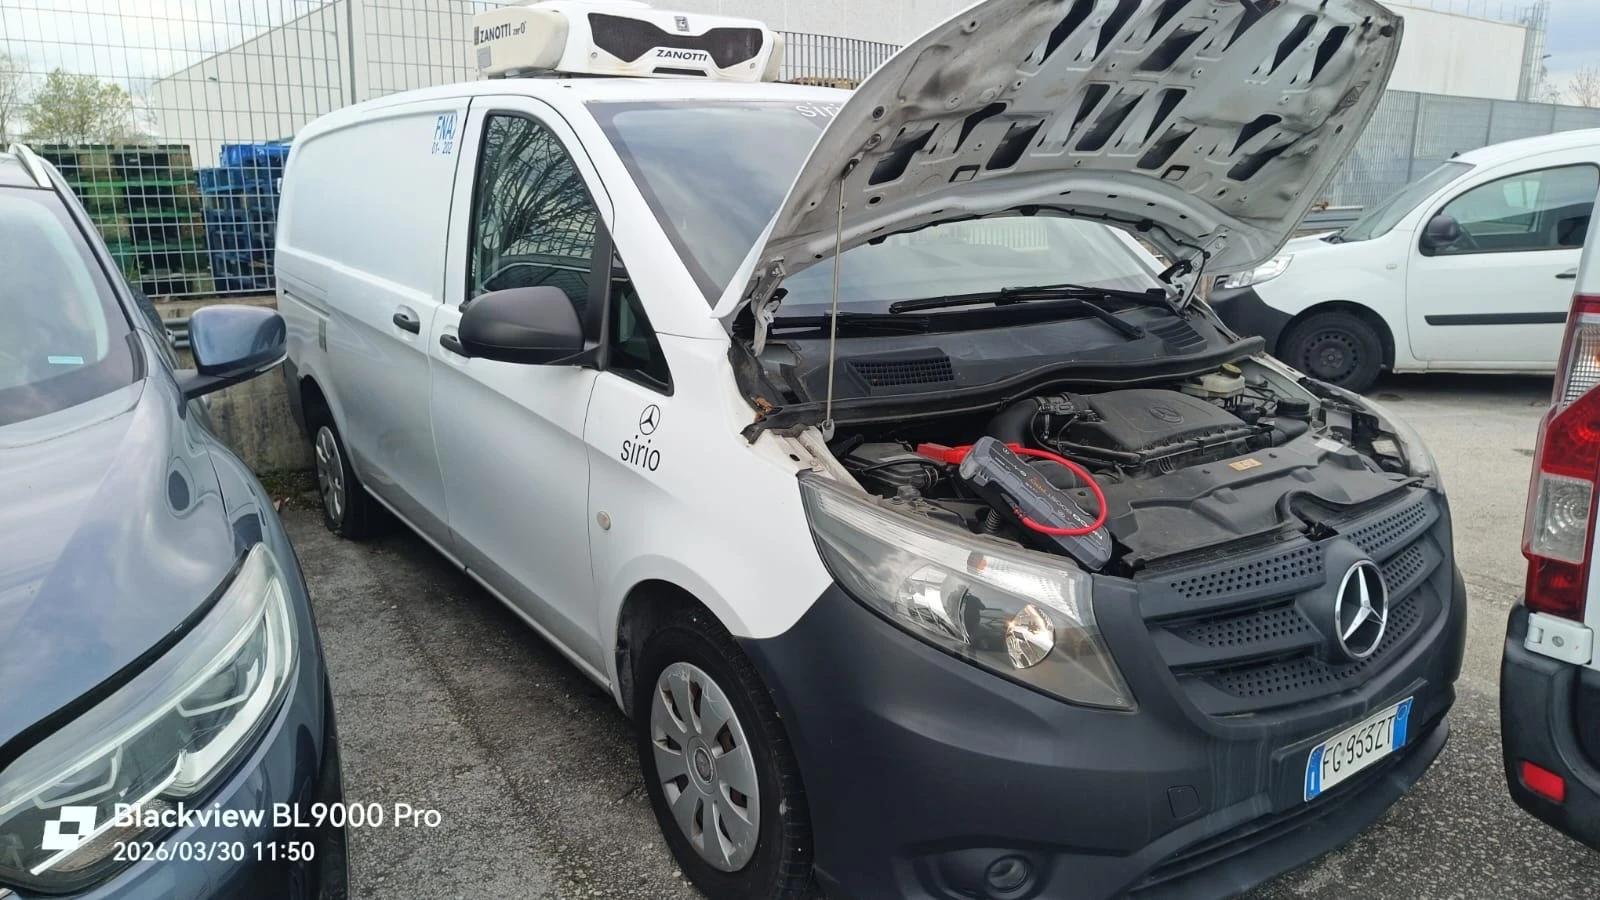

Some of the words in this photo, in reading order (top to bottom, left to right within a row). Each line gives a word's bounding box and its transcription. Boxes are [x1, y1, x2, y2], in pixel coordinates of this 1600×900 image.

[480, 23, 511, 43] ZANOTTI
[656, 49, 708, 61] ZANOTTI
[621, 435, 660, 471] sirio
[1322, 742, 1341, 780] FG
